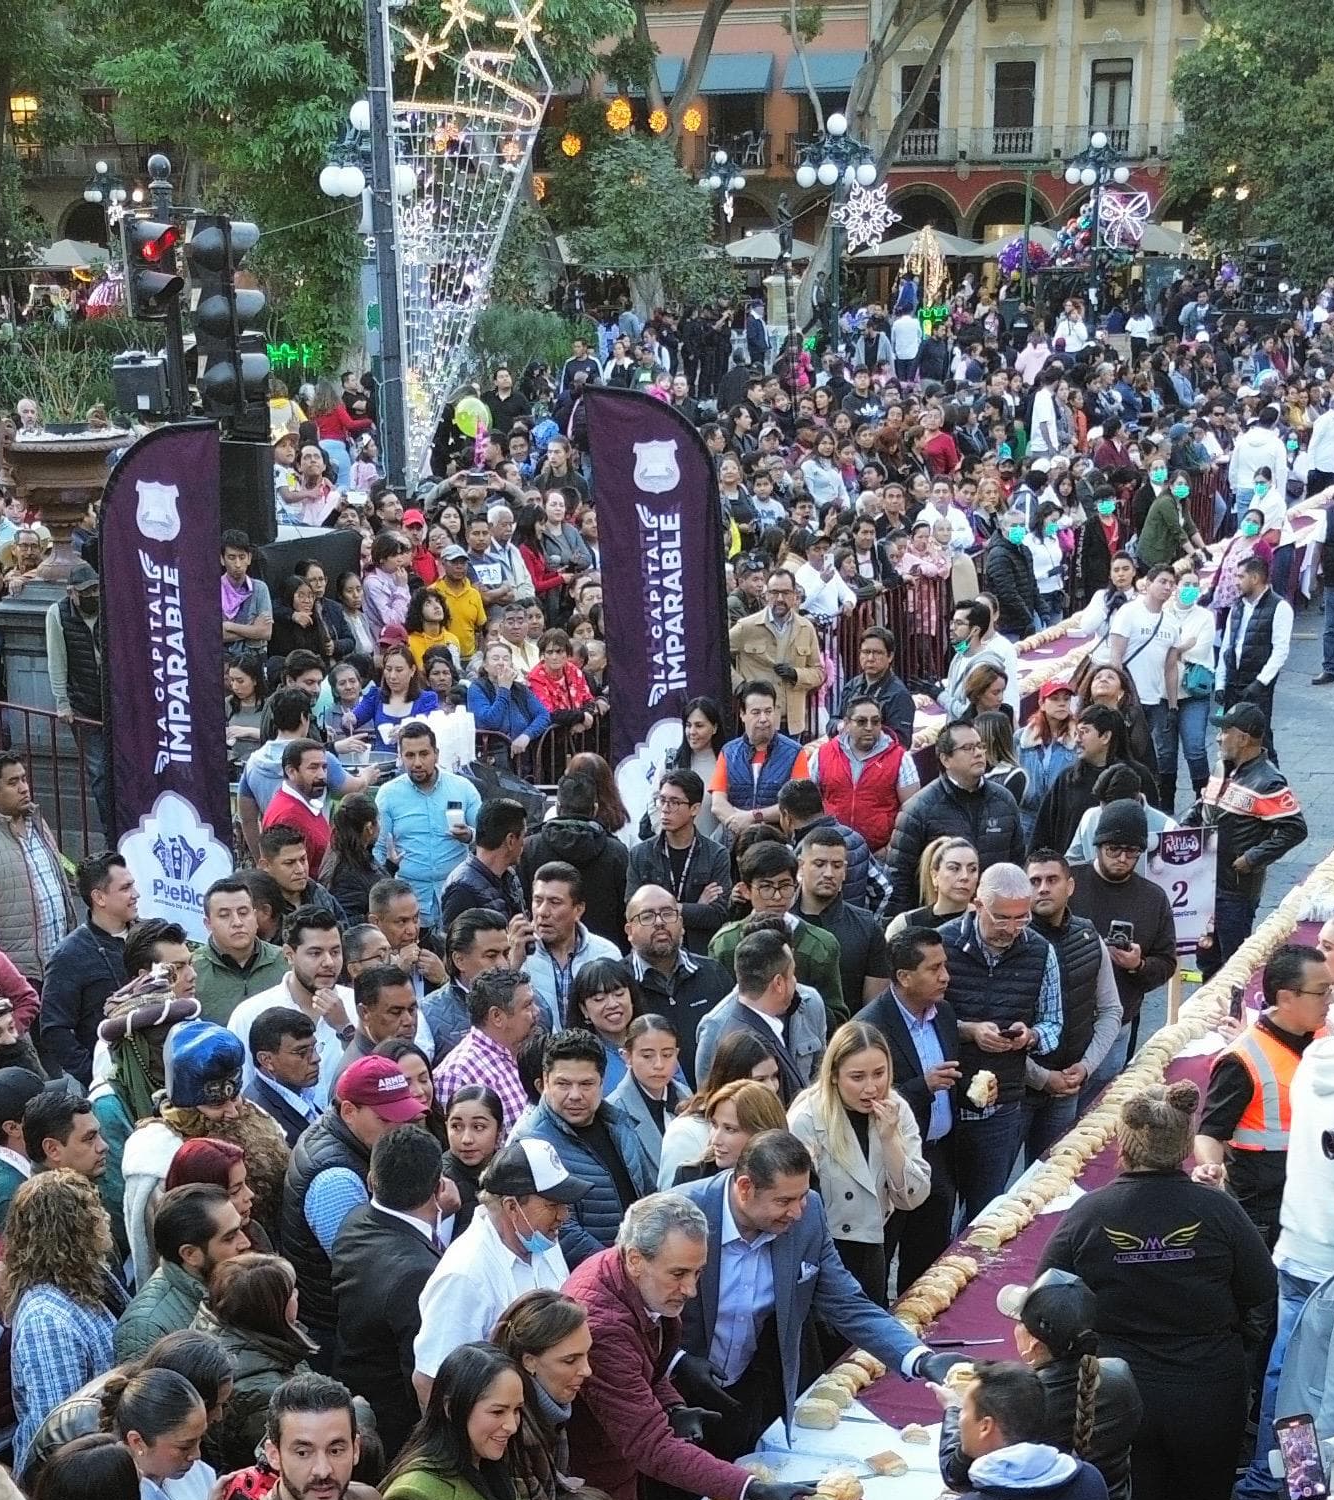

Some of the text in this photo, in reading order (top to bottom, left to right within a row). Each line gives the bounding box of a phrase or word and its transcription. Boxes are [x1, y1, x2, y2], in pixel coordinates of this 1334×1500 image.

[148, 582, 168, 747] LA CAPITAL
[163, 565, 192, 762] IMPARABLE
[646, 530, 666, 680] LA CAPITAL
[660, 513, 687, 690] IMPARABLE
[1172, 881, 1188, 908] 2
